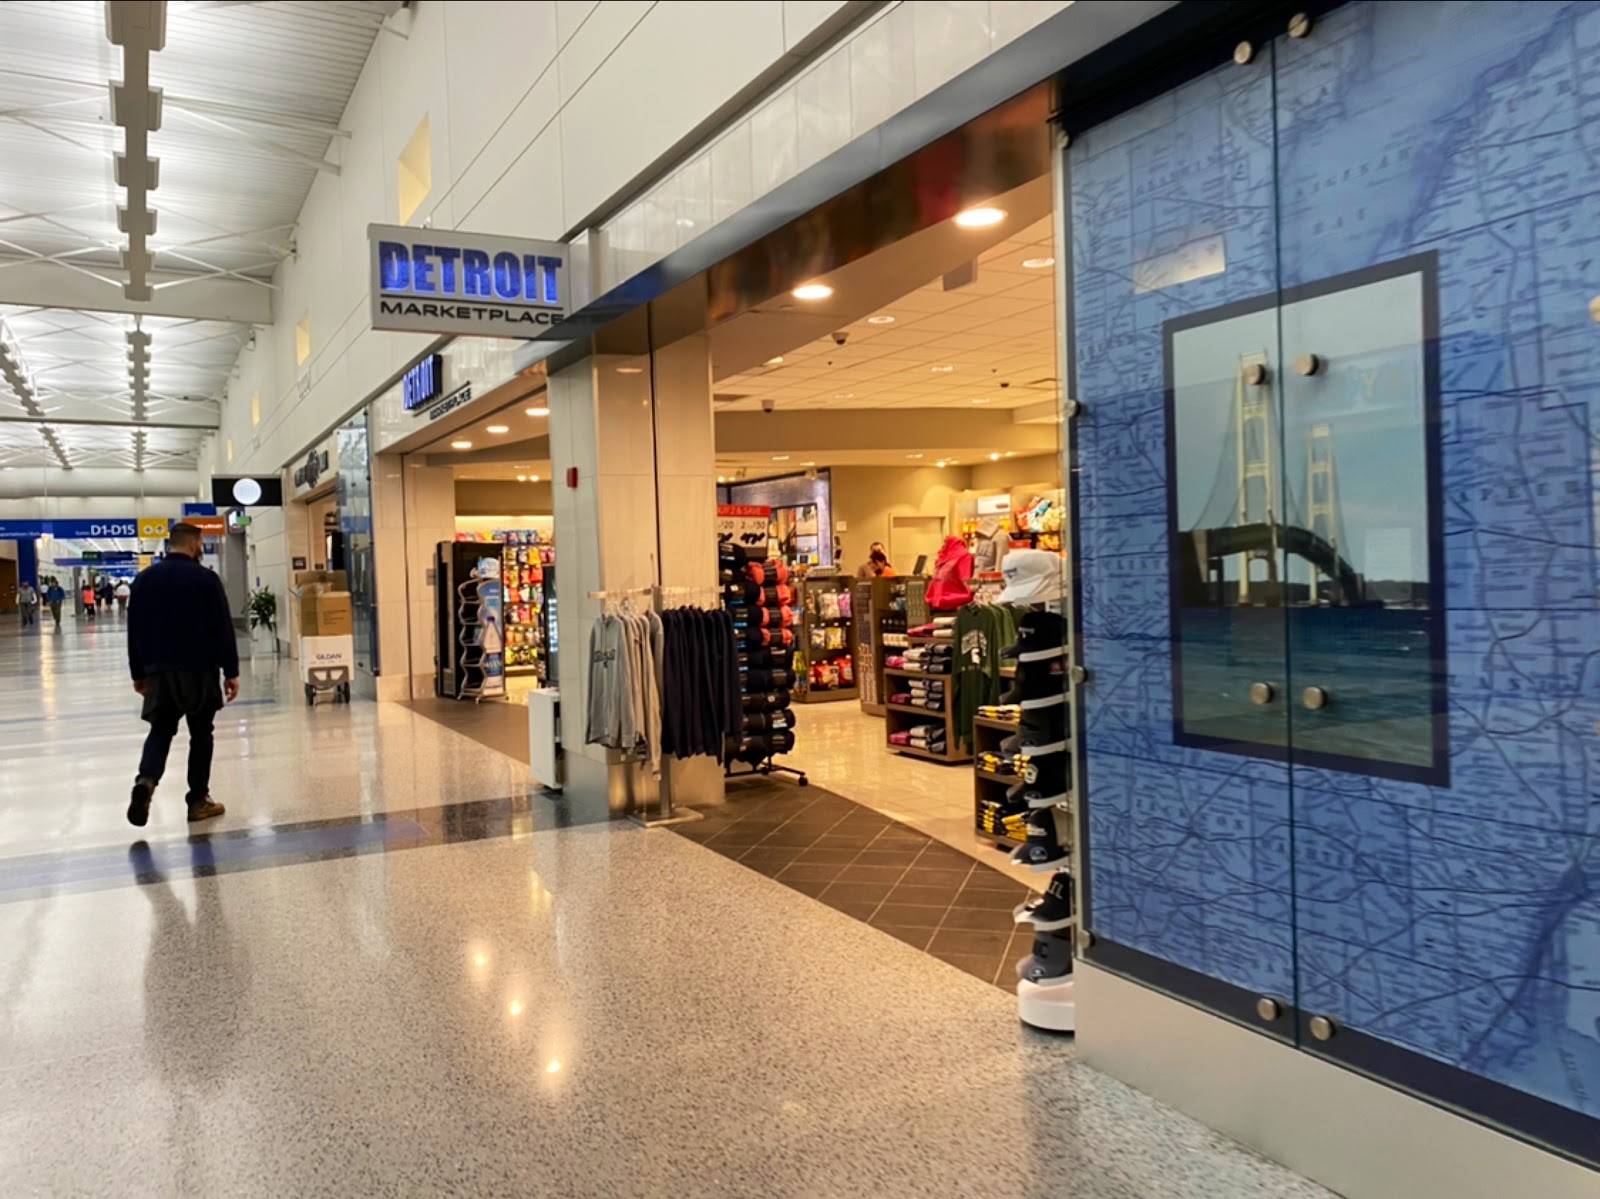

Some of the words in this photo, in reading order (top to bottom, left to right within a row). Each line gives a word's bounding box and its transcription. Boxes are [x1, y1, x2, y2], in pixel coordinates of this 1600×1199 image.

[378, 241, 562, 304] DETROIT
[380, 300, 565, 325] MARKETPLACE
[90, 524, 135, 536] D1-D15
